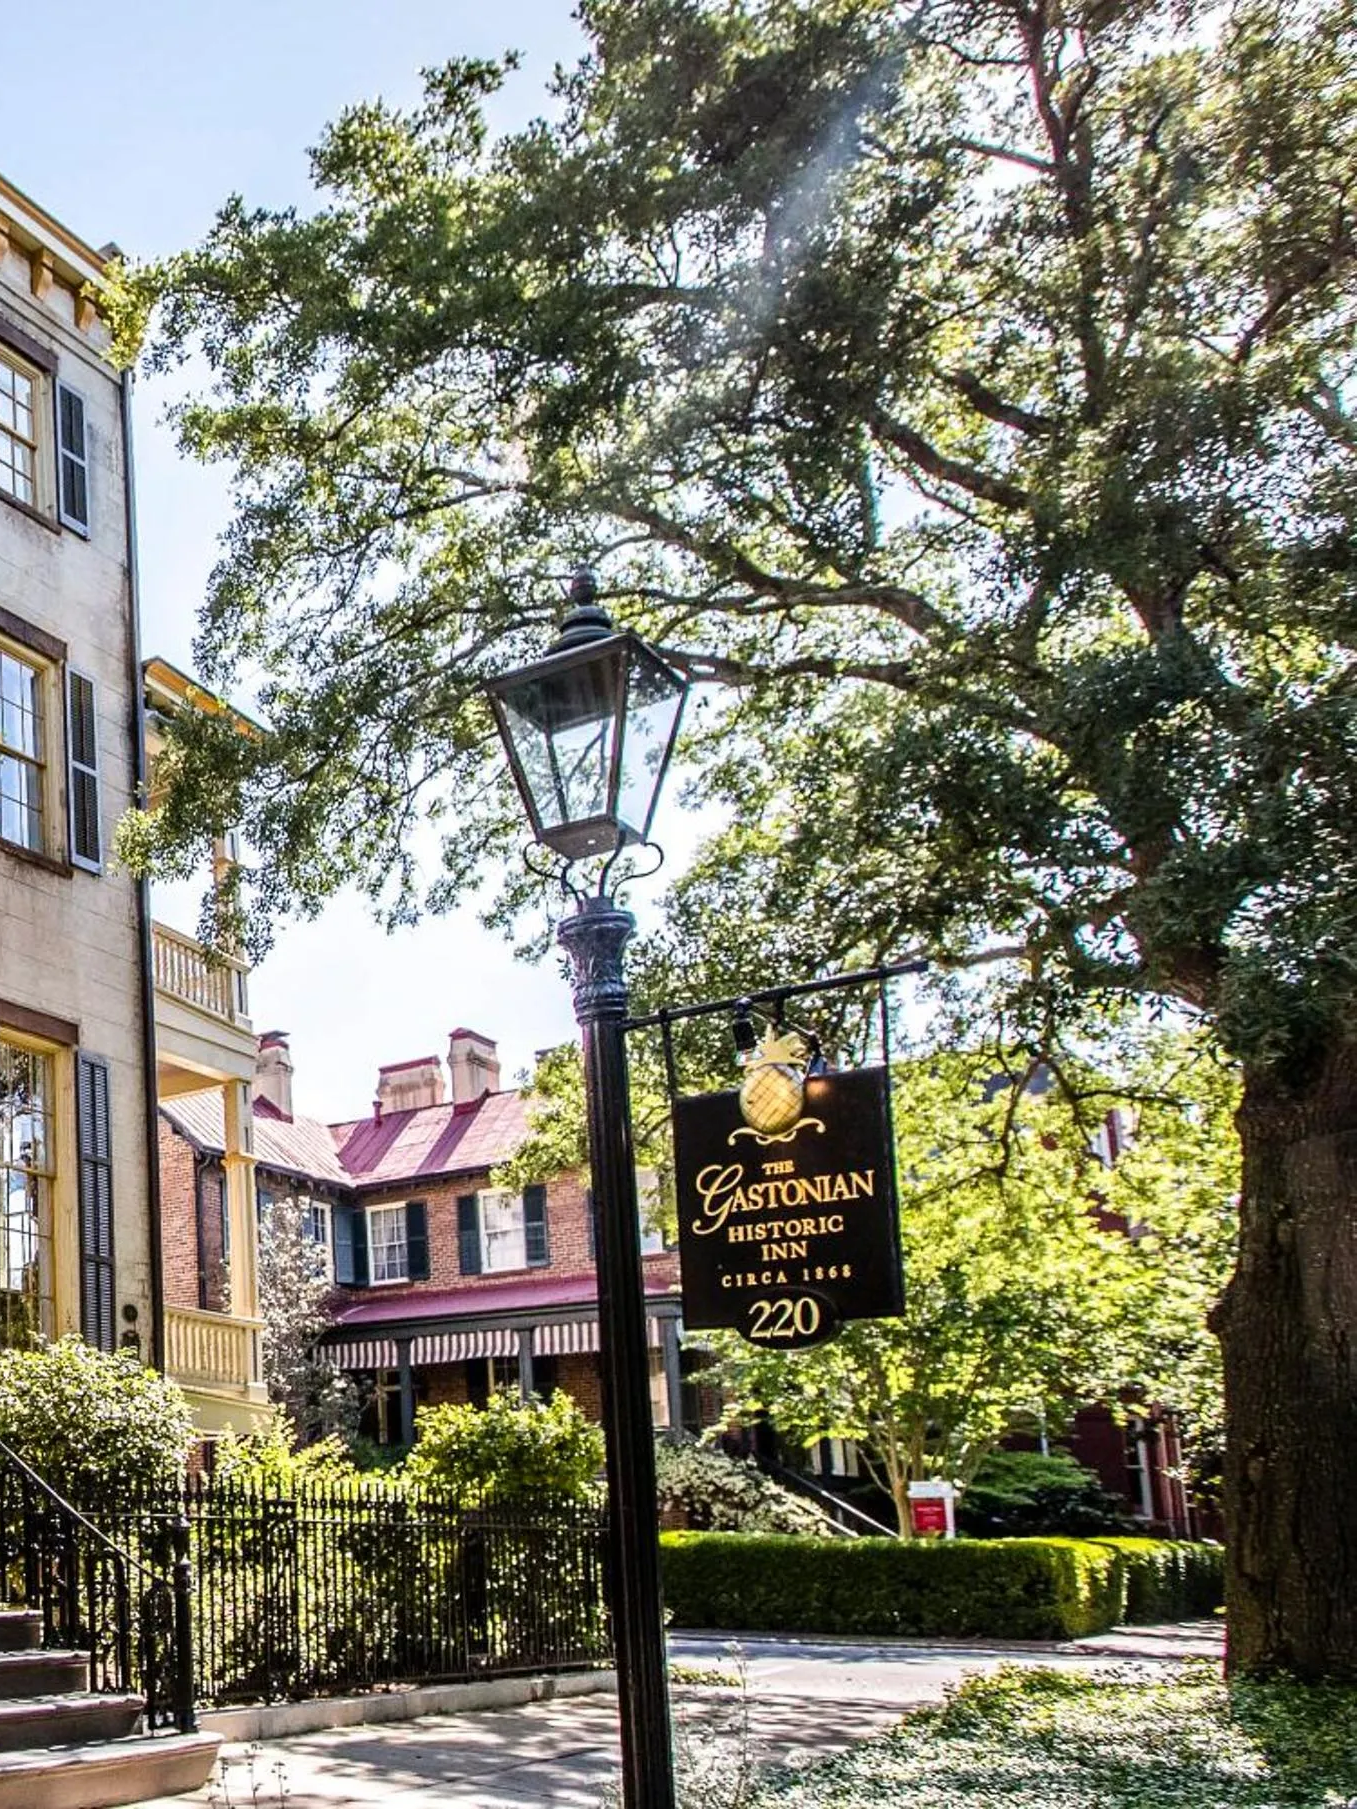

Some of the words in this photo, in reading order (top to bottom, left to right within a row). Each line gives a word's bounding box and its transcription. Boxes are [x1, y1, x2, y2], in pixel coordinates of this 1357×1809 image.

[762, 1161, 794, 1176] THE
[692, 1164, 875, 1235] GASTONIAN
[727, 1215, 844, 1243] HISTORIC
[761, 1240, 808, 1262] INN
[721, 1269, 788, 1288] CIRCA
[802, 1263, 853, 1282] 1868
[748, 1297, 820, 1338] 220
